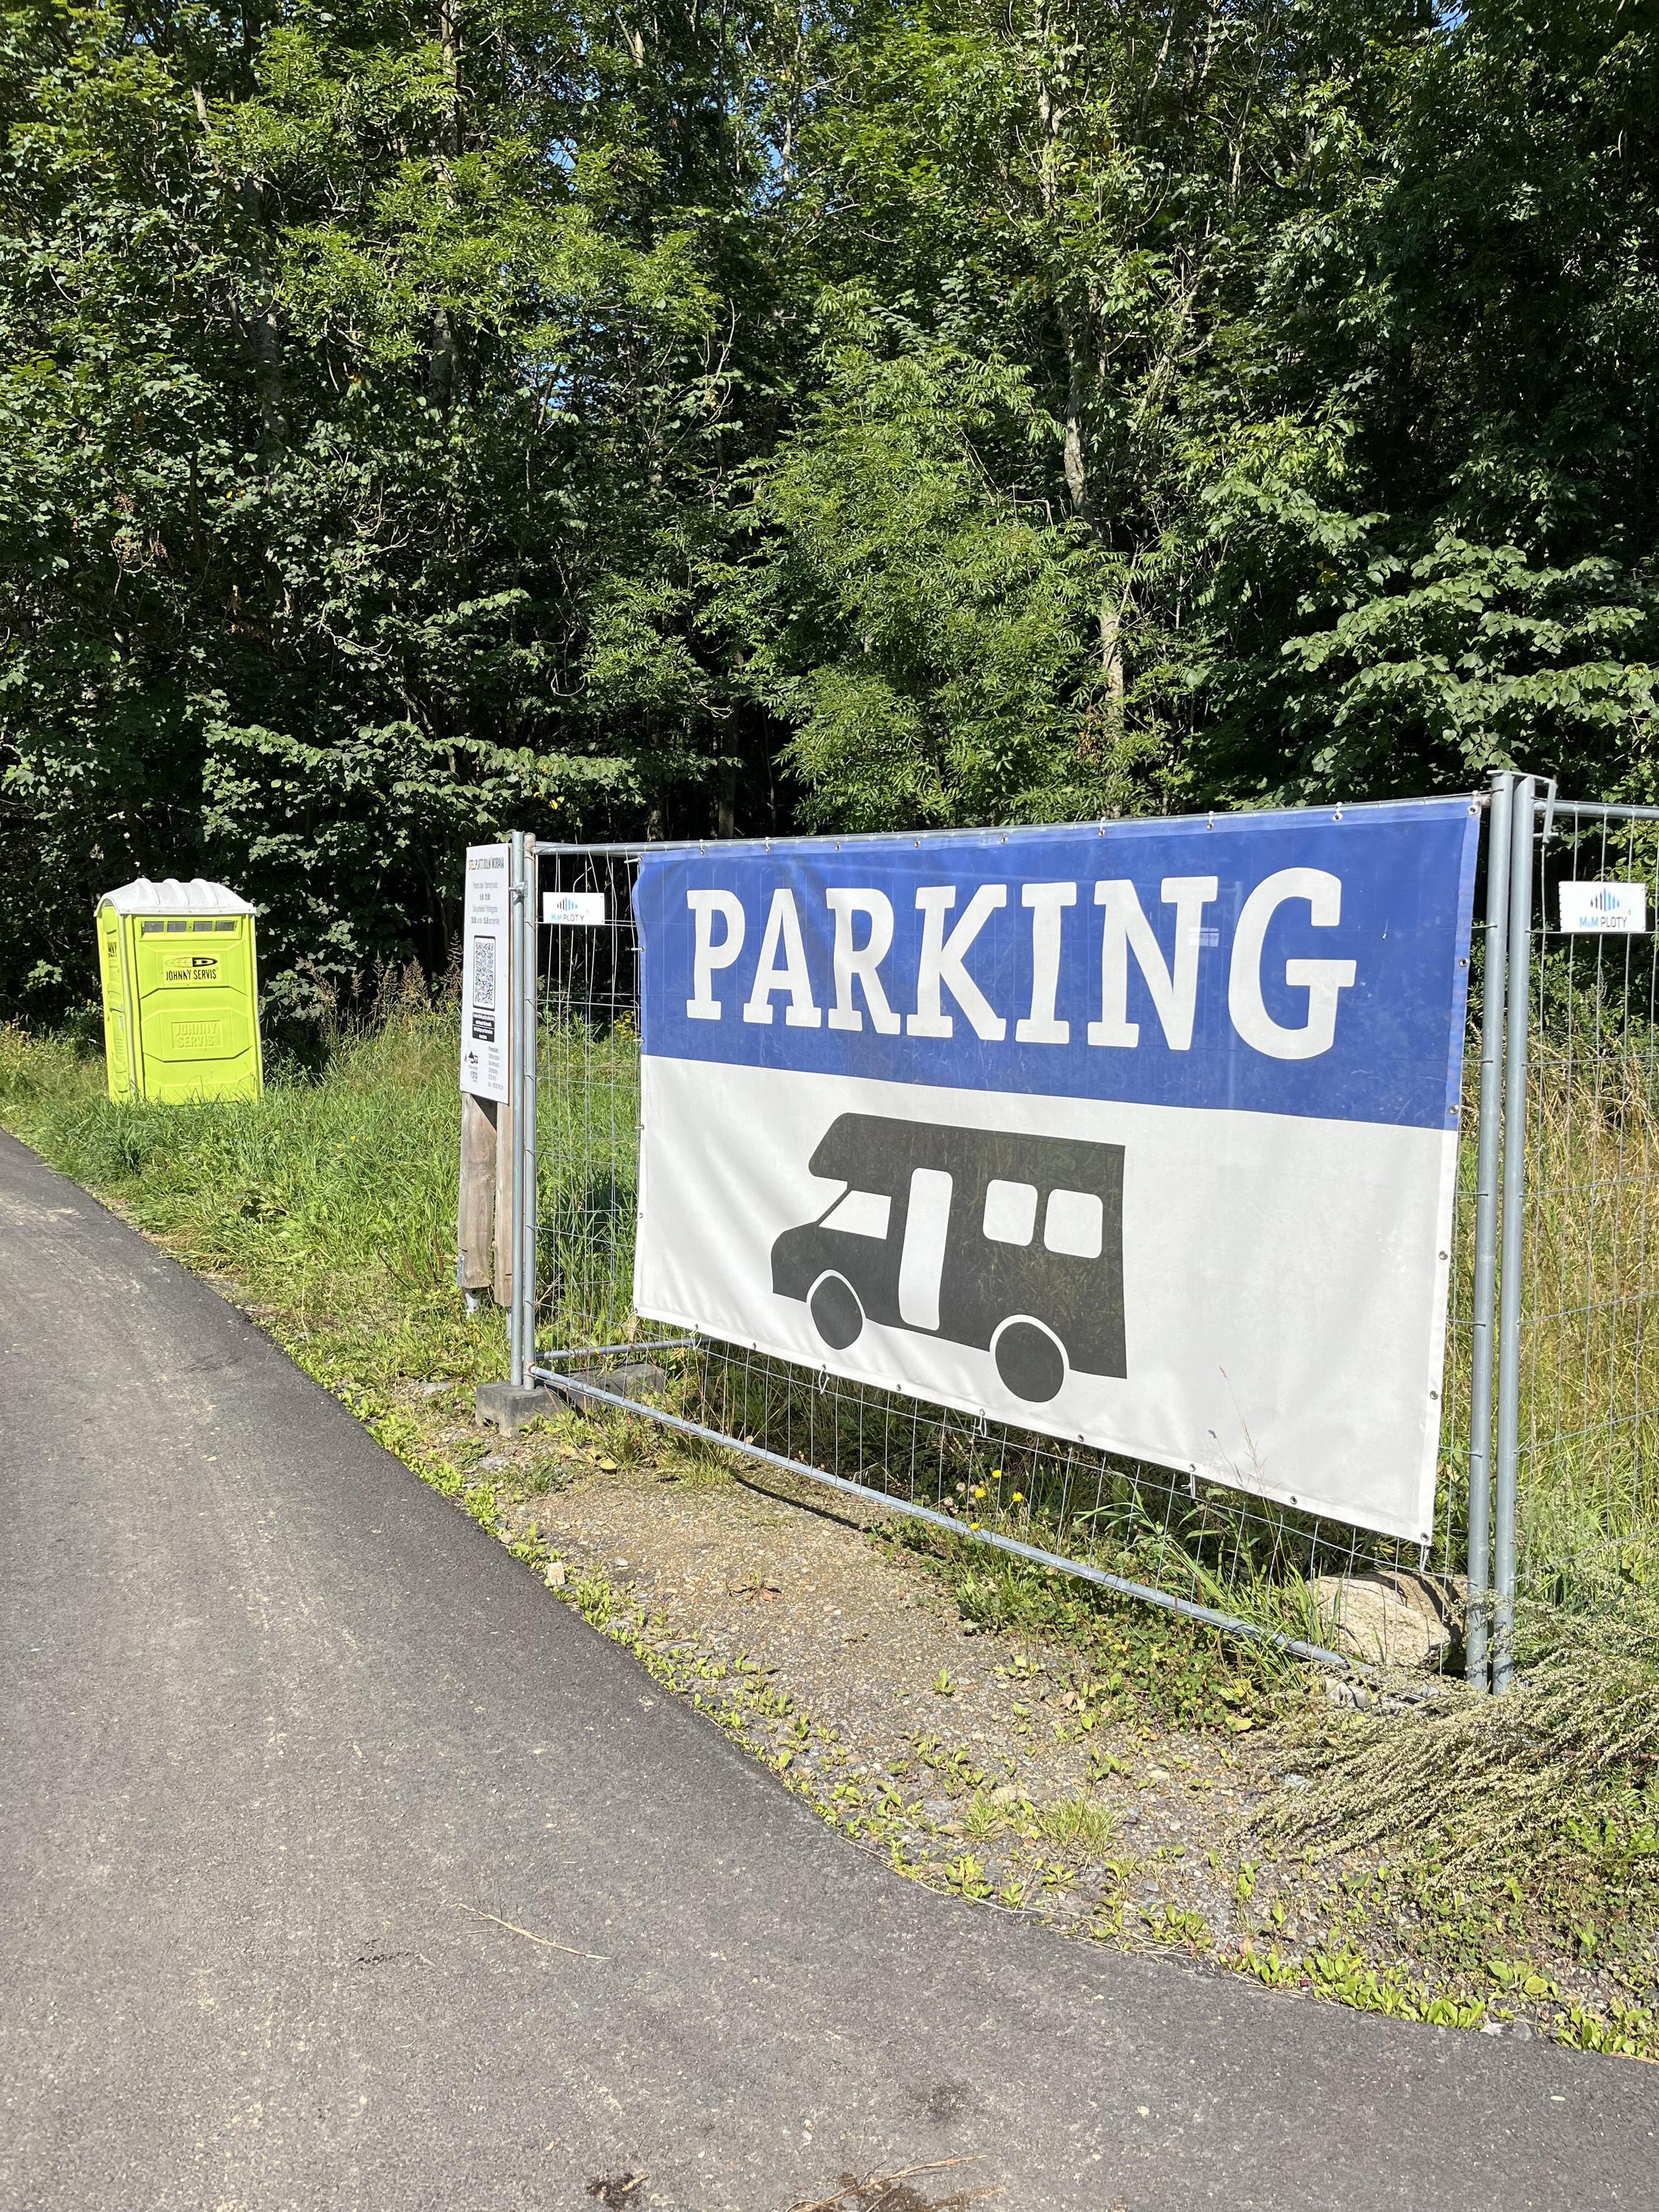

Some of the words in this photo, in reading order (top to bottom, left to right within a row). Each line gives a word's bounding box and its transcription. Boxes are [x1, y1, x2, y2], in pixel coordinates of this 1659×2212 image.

[1601, 917, 1628, 928] PLOTY
[686, 866, 1357, 1060] PARKING
[166, 969, 192, 981] JOHNNY
[193, 969, 217, 980] SERVIS
[176, 1023, 217, 1036] JOHNNY
[177, 1035, 214, 1048] SERVIS
